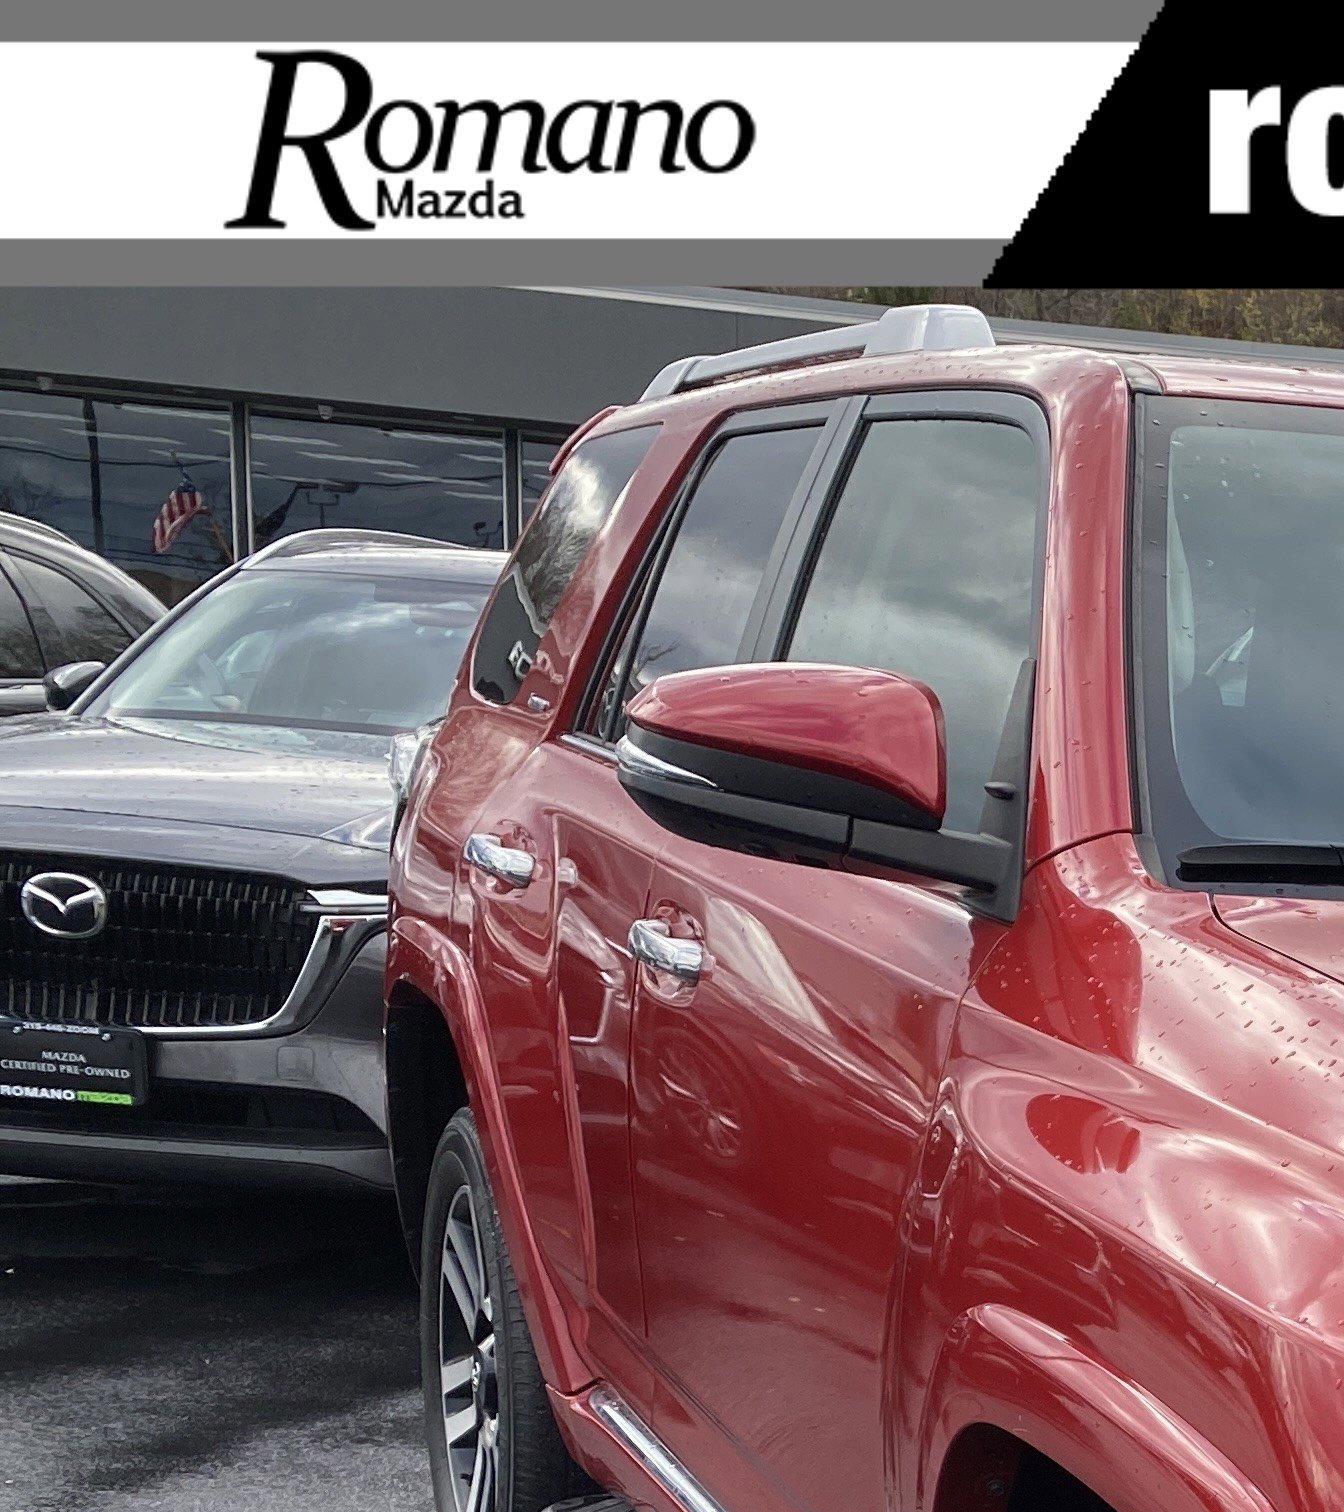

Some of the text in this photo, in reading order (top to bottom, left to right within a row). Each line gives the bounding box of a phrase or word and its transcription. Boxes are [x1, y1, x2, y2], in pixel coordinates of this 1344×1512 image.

[41, 1050, 87, 1062] MAZDA
[0, 1059, 131, 1079] CERTIFIED PRE-OWNED
[0, 1084, 75, 1101] ROMANO
